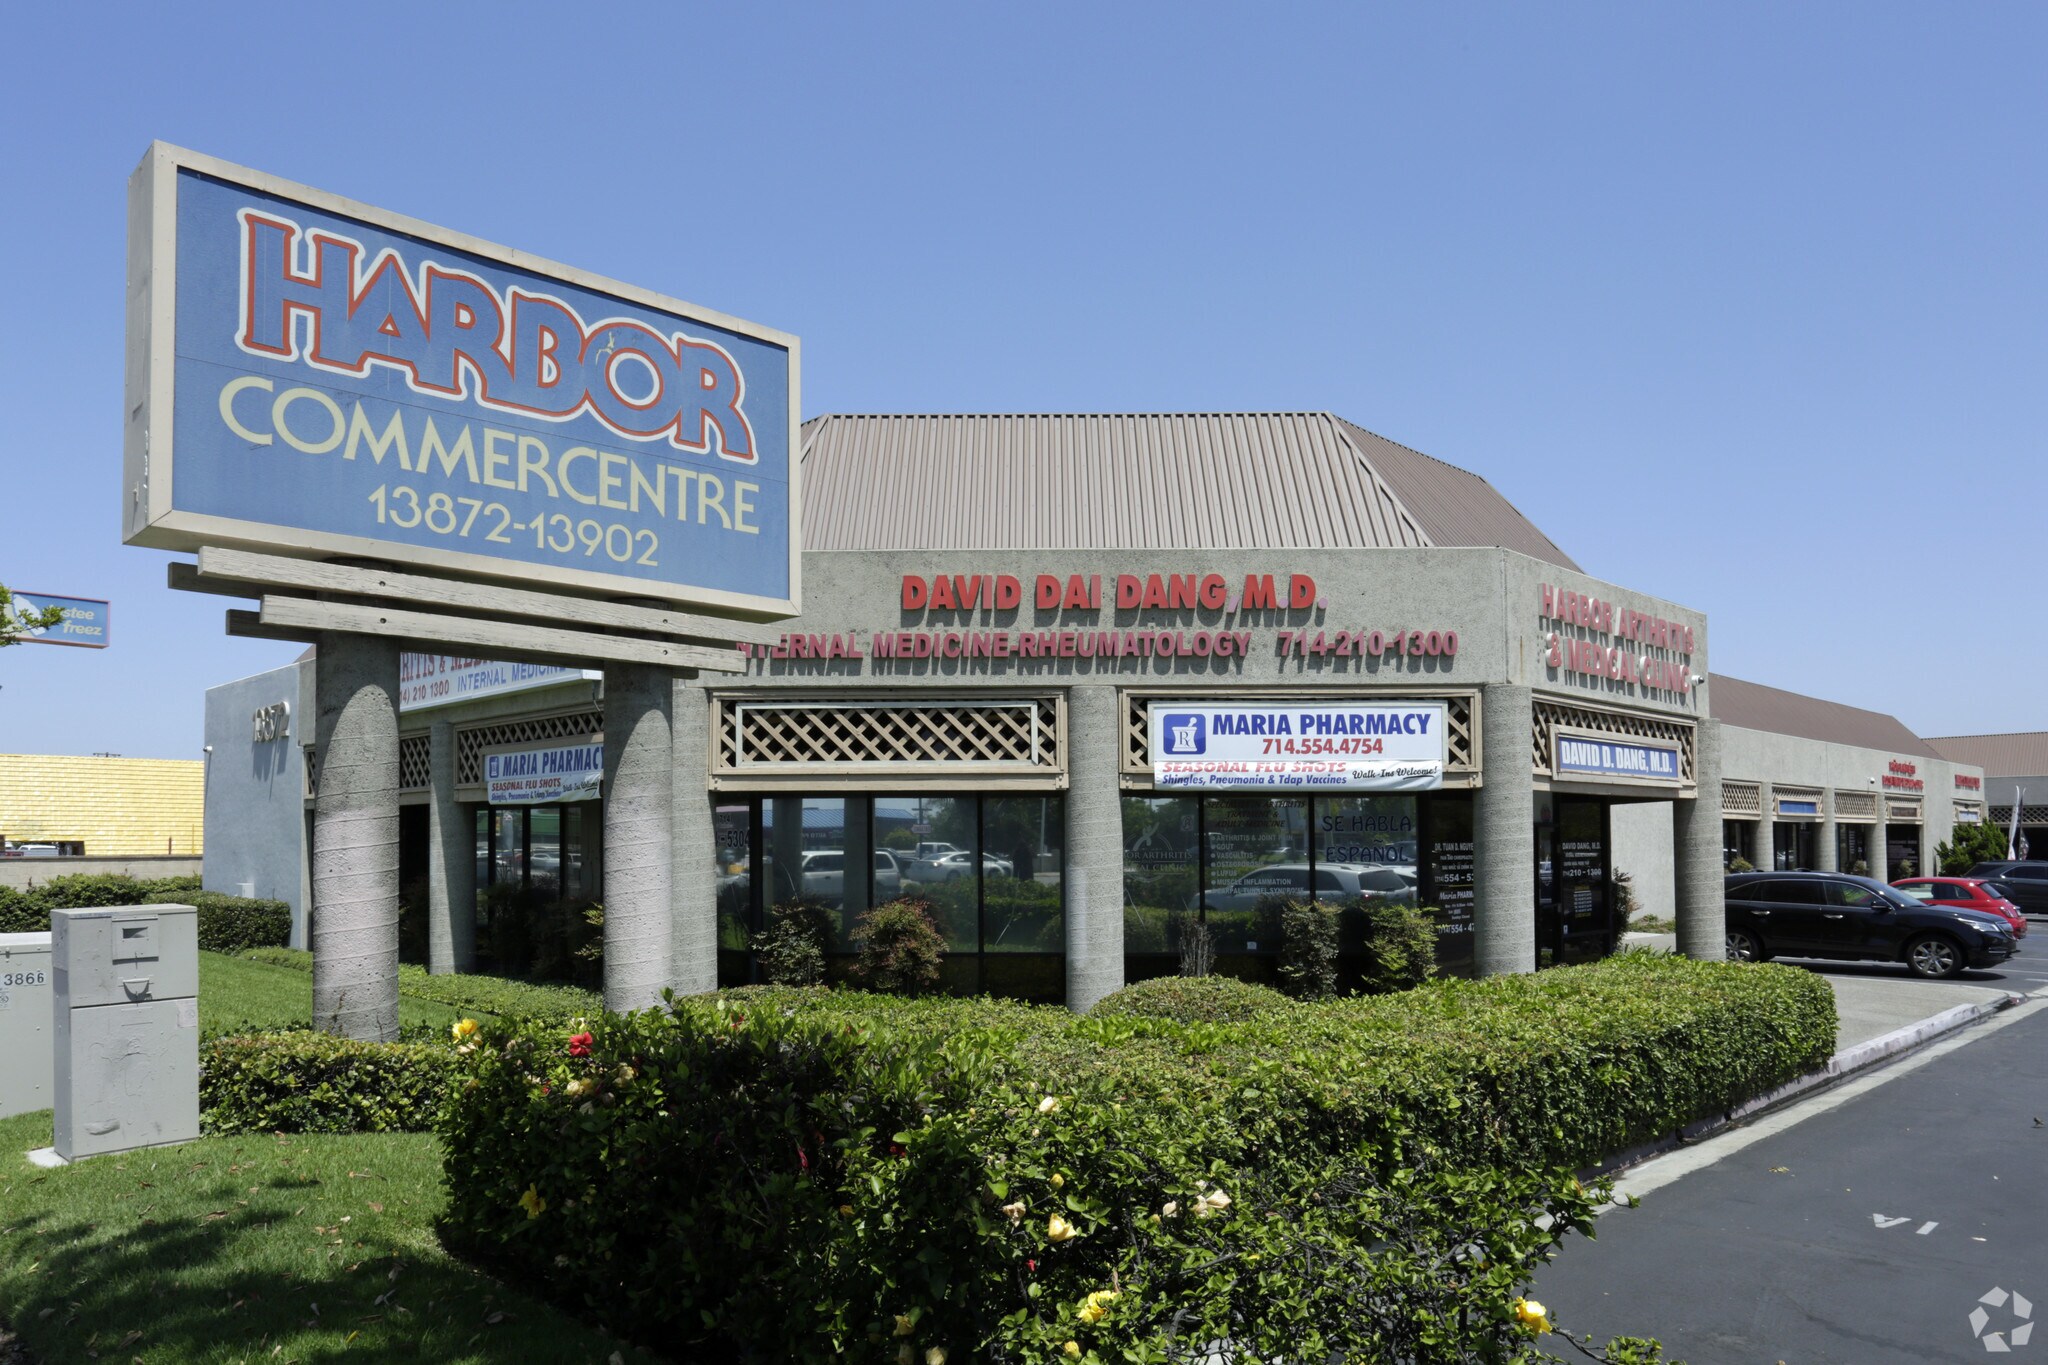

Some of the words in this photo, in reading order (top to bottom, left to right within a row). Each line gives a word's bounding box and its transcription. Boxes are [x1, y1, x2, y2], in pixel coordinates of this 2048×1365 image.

[236, 208, 758, 465] HARBOR
[219, 375, 760, 535] COMMERCENTRE
[369, 484, 659, 567] 13872-13902
[903, 575, 1021, 610] DAVID
[1037, 575, 1101, 609] DAI
[63, 620, 102, 635] freez
[1538, 583, 1612, 634] HARBOR
[1615, 607, 1694, 655] ARTHRITIS
[1278, 630, 1459, 657] 714-210-1300
[400, 652, 435, 682] RITIS
[1546, 633, 1562, 667] &
[1564, 639, 1639, 684] MEDICAL
[1640, 656, 1690, 694] CLINIC
[413, 684, 427, 702] 210
[430, 679, 450, 698] 1300
[457, 667, 506, 693] INTERNAL
[512, 663, 567, 682] MEDICIN
[1212, 714, 1292, 735] MARIA
[1300, 713, 1432, 735] PHARMACY
[1262, 738, 1383, 755] 714.554.4754
[1561, 741, 1600, 767] DAVID
[1602, 746, 1614, 768] D.
[1615, 747, 1649, 773] DANG,
[1650, 750, 1673, 773] M.D.
[503, 753, 538, 777] MARIA
[1162, 761, 1249, 773] SEASONAL
[1255, 761, 1287, 773] FLU
[1291, 761, 1347, 773] SHOTS
[491, 782, 523, 792] SEASONAL
[525, 780, 538, 789] FLU
[539, 778, 561, 788] SHOTS
[1162, 774, 1206, 786] Shingles,
[1209, 774, 1265, 784] Pneumonia
[1267, 775, 1276, 784] &
[1279, 774, 1303, 786] Tdap
[1306, 774, 1347, 784] Vaccines
[1322, 815, 1344, 832] SE
[1351, 815, 1412, 832] HABLA
[1216, 843, 1234, 851] GOUT
[1460, 842, 1474, 851] NGUYE
[1456, 890, 1474, 899] PHARM
[4, 972, 45, 986] 3866
